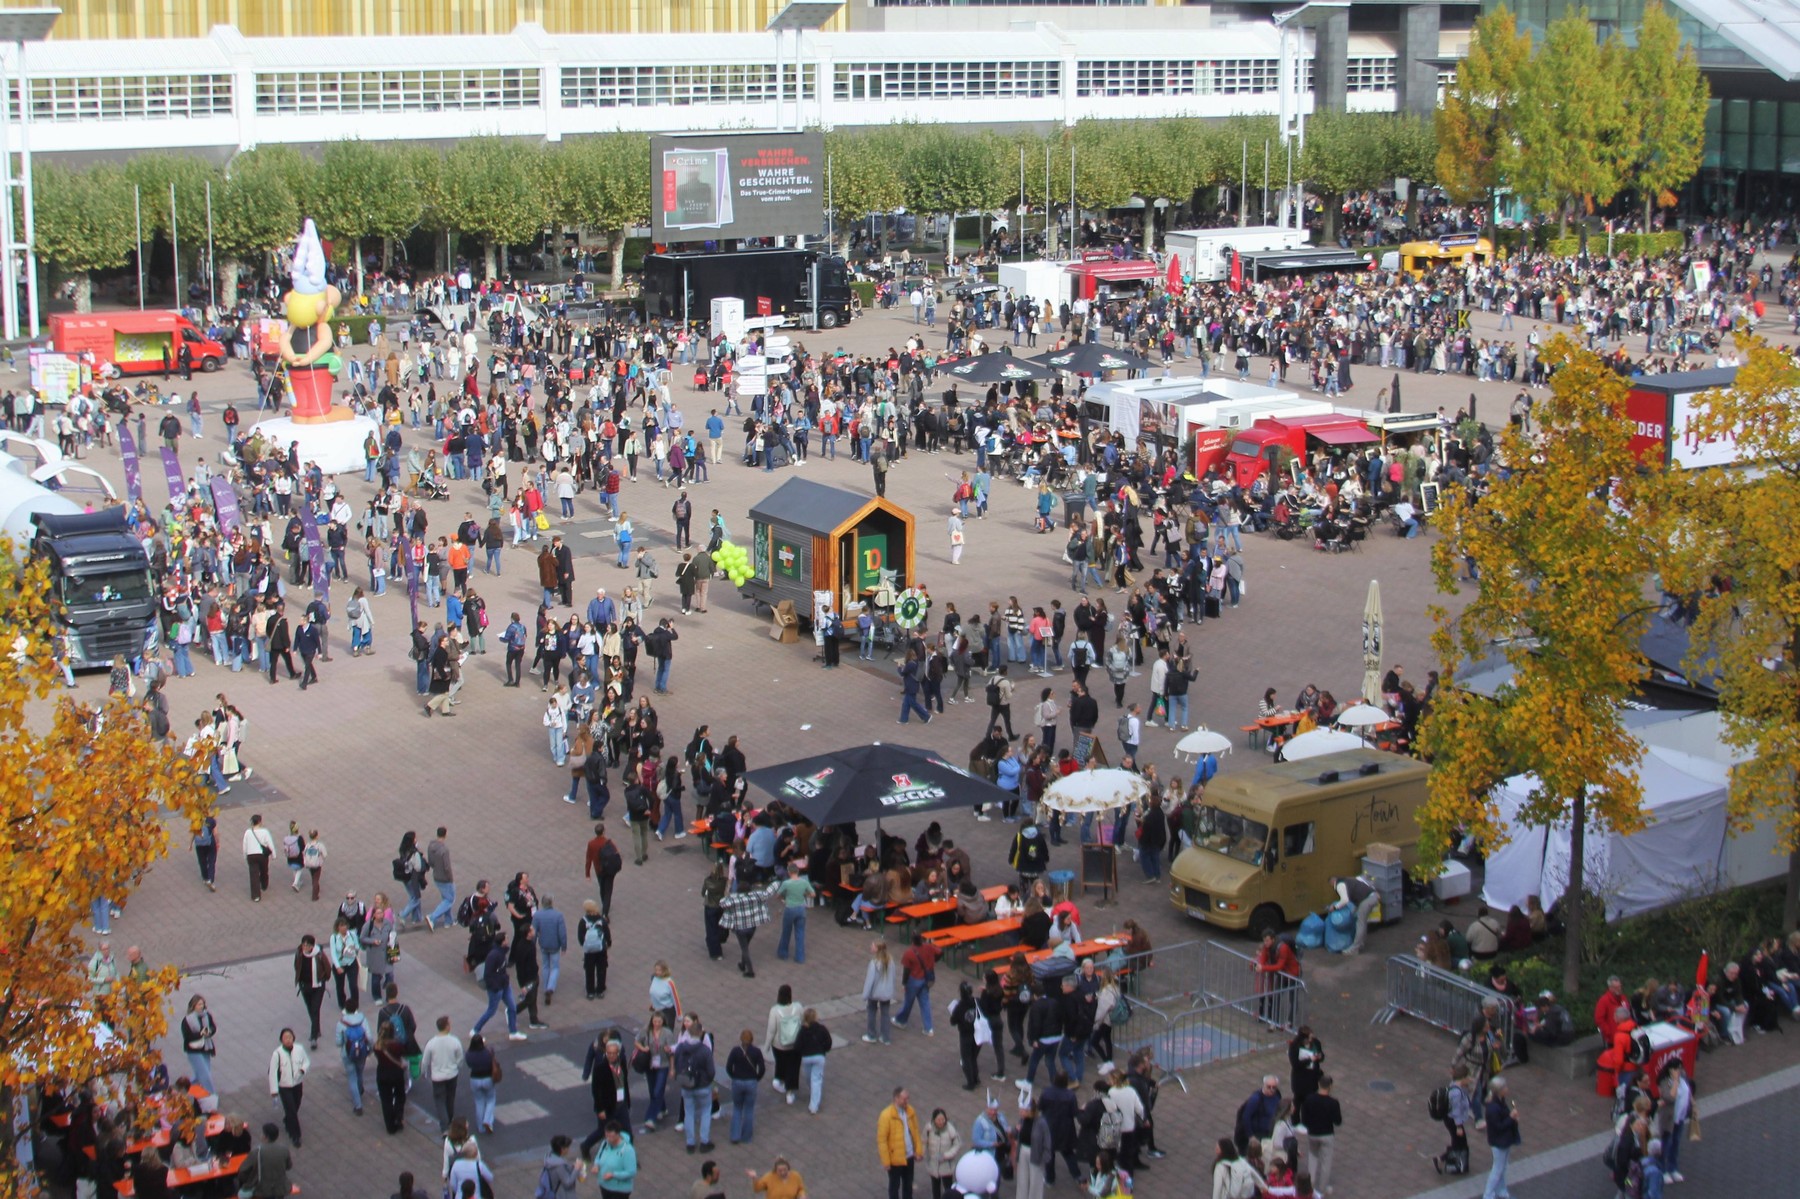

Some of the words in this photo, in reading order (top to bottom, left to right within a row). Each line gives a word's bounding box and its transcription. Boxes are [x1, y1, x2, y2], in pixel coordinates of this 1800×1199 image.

[758, 148, 794, 157] WAHRE
[676, 157, 708, 166] Crime
[740, 156, 811, 167] VERBRECHEN.
[758, 168, 795, 177] WAHRE
[739, 177, 813, 187] GESCHICHTEN.
[863, 548, 882, 571] 10
[785, 776, 822, 799] BECK'S
[879, 788, 946, 806] BECK'S
